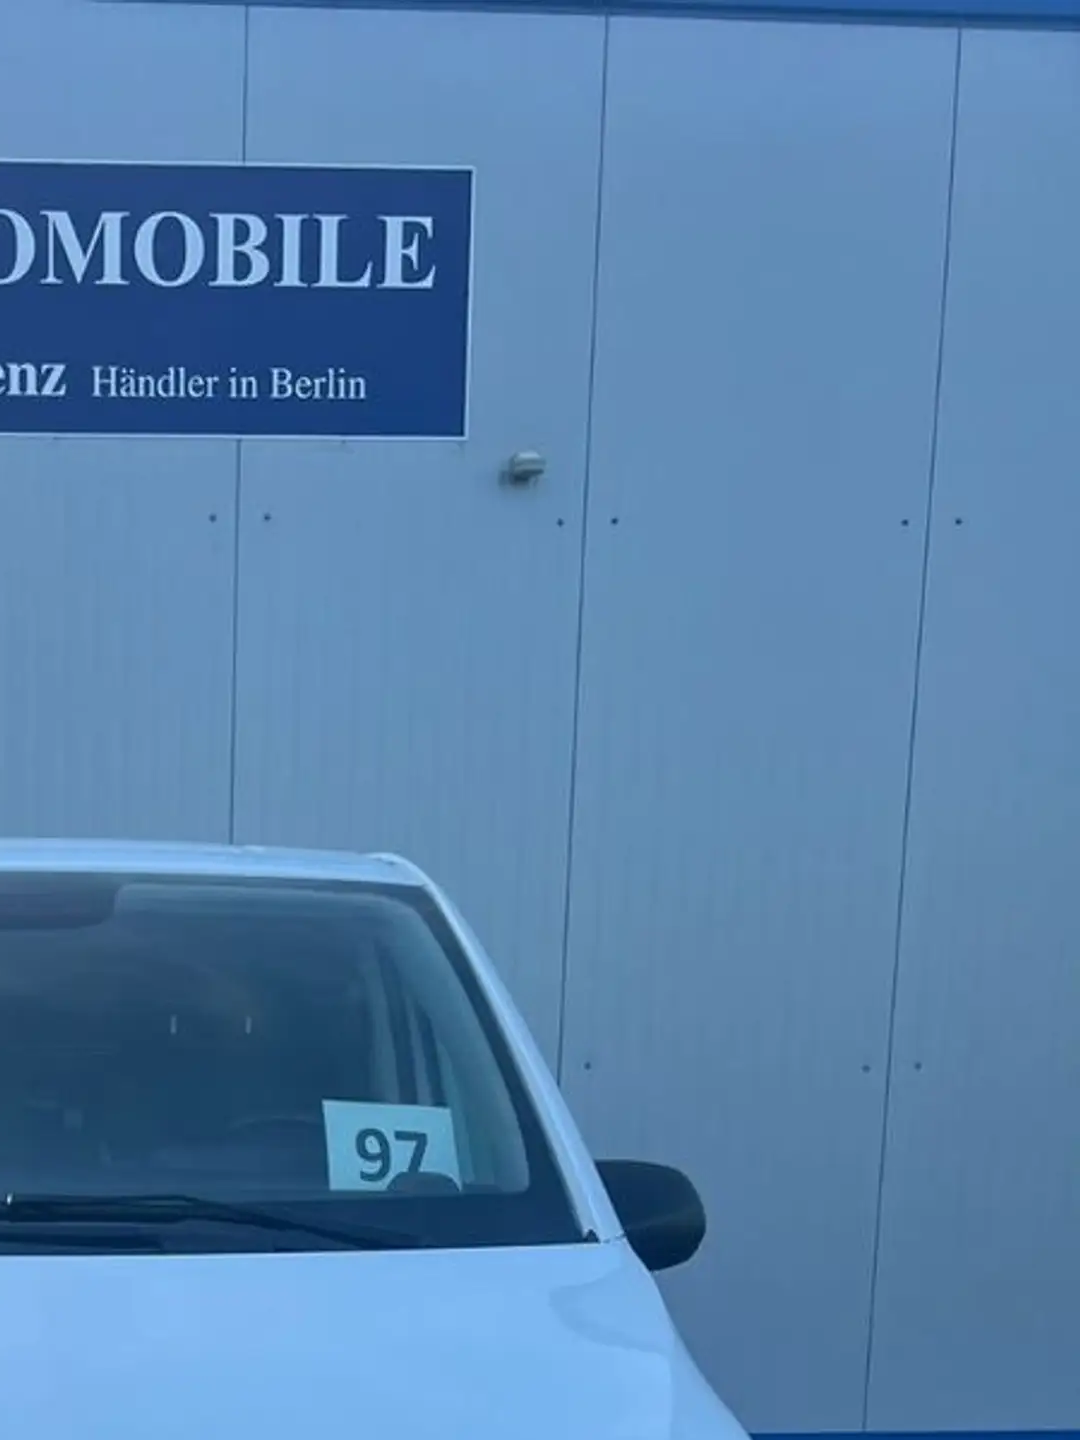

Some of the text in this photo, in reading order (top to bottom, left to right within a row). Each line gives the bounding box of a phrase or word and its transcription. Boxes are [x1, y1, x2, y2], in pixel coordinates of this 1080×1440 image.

[91, 366, 218, 399] Händler
[228, 367, 258, 398] in
[270, 368, 367, 400] Berlin
[355, 1127, 428, 1182] 97
